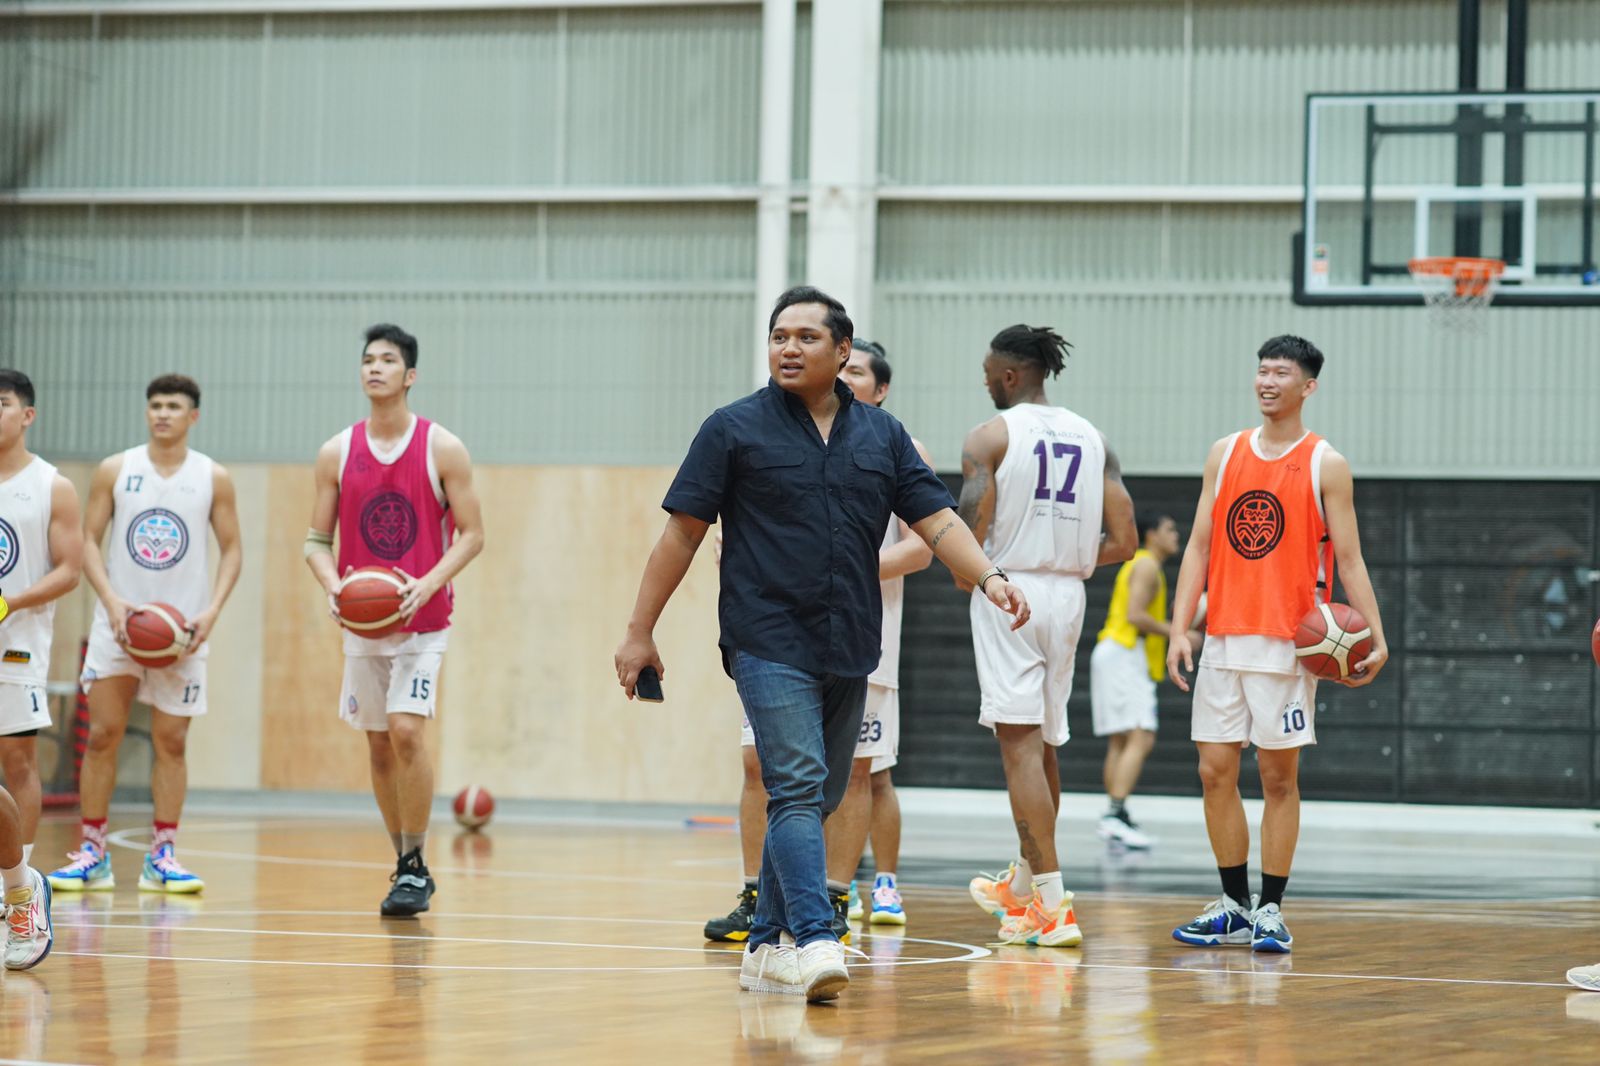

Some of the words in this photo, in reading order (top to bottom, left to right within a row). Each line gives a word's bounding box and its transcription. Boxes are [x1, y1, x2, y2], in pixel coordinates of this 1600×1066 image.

[1033, 439, 1082, 504] 17
[125, 475, 144, 492] 17
[181, 684, 200, 704] 17
[410, 677, 430, 700] 15
[30, 691, 39, 712] 1
[858, 720, 882, 743] 23
[1282, 708, 1306, 734] 10
